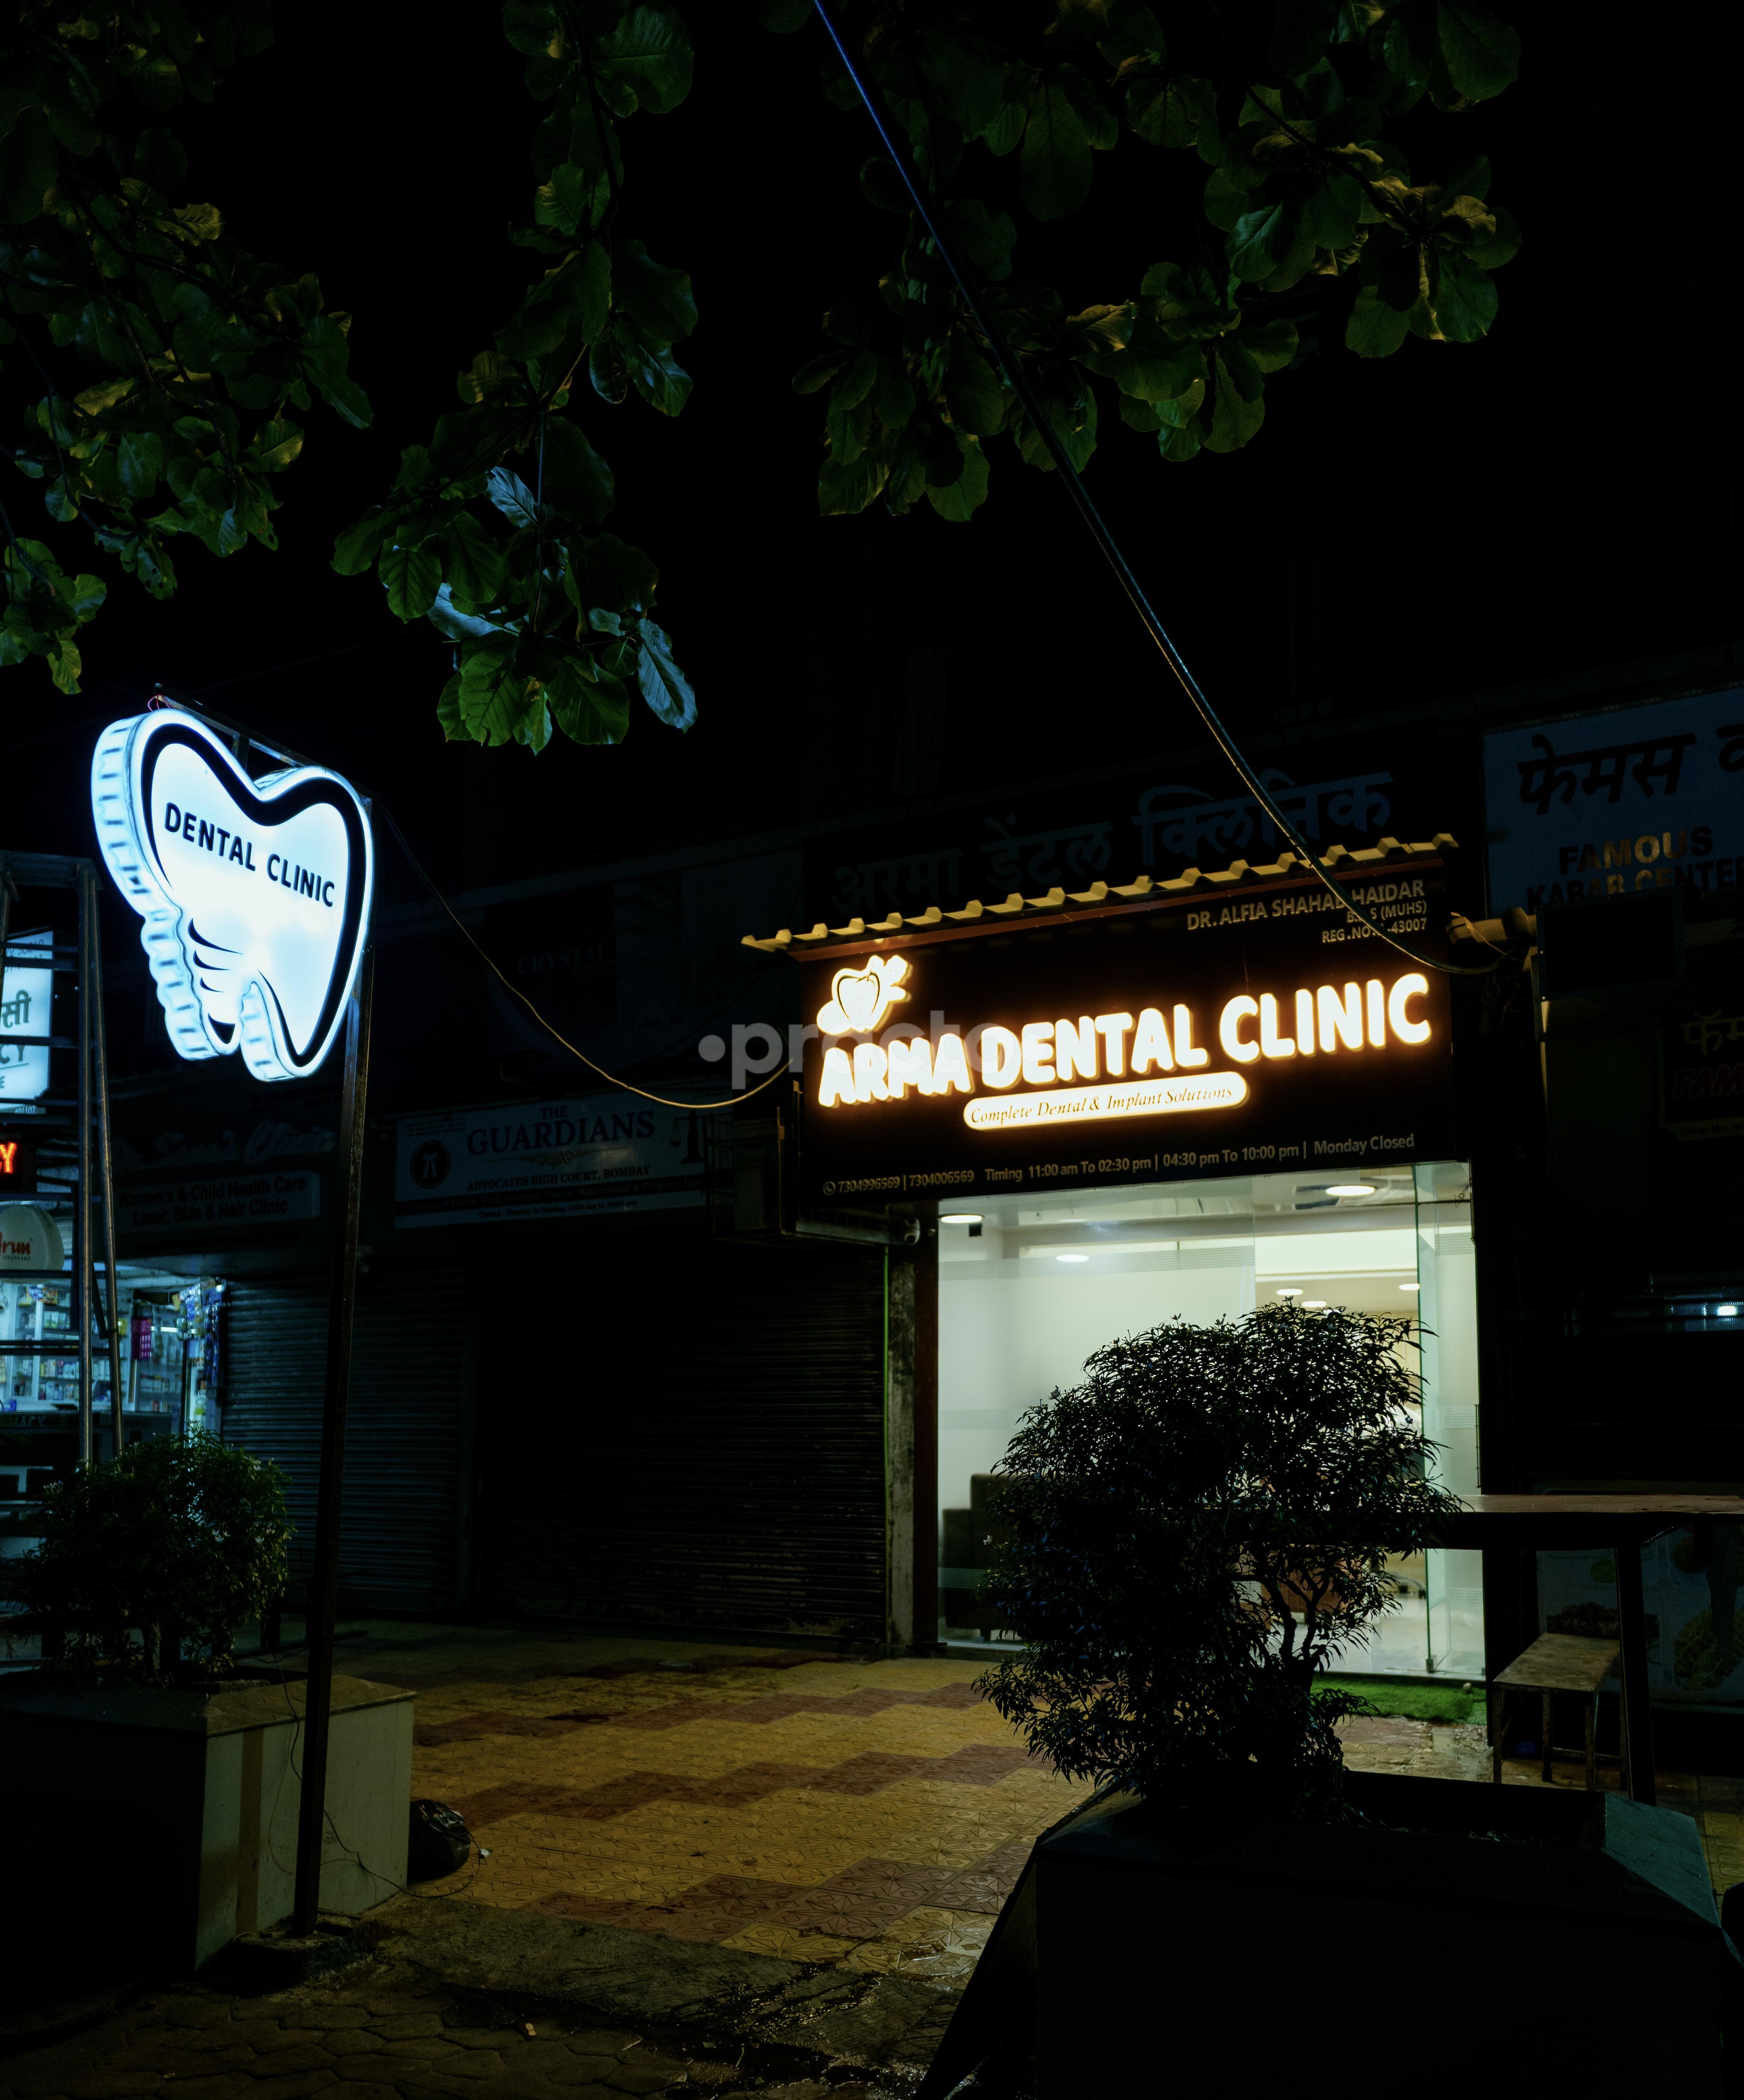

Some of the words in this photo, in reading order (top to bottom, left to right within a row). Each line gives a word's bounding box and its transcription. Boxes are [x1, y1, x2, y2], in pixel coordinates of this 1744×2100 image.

[1518, 733, 1696, 815] फेमस
[165, 802, 255, 871] DENTAL
[267, 854, 334, 907] CLINIC
[831, 846, 964, 916] अरमा
[979, 812, 1114, 891] डेंटल
[1129, 767, 1394, 867] क्लिनिक
[1560, 827, 1713, 874] FAMOUS
[1219, 902, 1268, 925] ALFIA
[1351, 879, 1425, 905] HAIDAR
[1380, 900, 1427, 920] (MUHS)
[818, 1033, 973, 1107] ARMA
[981, 1004, 1209, 1089] DENTAL
[1219, 973, 1431, 1063] CLINIC
[541, 1105, 568, 1119] THE
[971, 1107, 1033, 1124] Complete
[1037, 1098, 1087, 1116] Dental
[1090, 1099, 1100, 1110] &
[1107, 1093, 1163, 1110] Implant
[1165, 1088, 1233, 1105] Solutions
[467, 1110, 655, 1156] GUARDIANS
[467, 1176, 528, 1191] ADVOCATES
[531, 1174, 558, 1185] HIGH
[560, 1172, 601, 1183] COURT,
[603, 1165, 651, 1179] BOMBAY
[837, 1176, 900, 1193] 7304996569
[908, 1170, 975, 1187] 7304006569
[984, 1167, 1023, 1183] Timing
[1028, 1163, 1058, 1178] 11:00
[1060, 1165, 1078, 1176] am
[1080, 1161, 1096, 1174] To
[1098, 1157, 1130, 1173] 02:30
[1132, 1159, 1152, 1173] pm
[1162, 1152, 1196, 1168] 04:30
[1199, 1154, 1220, 1168] pm
[1222, 1149, 1238, 1163] To
[1242, 1145, 1276, 1161] 10:00
[1279, 1145, 1299, 1161] pm
[1314, 1138, 1368, 1156] Monday
[1370, 1133, 1415, 1150] Closed
[119, 1188, 175, 1207] Women's
[178, 1186, 186, 1202] &
[191, 1182, 223, 1201] Child
[228, 1178, 270, 1198] Health
[274, 1176, 306, 1194] Care
[133, 1210, 170, 1226] Laser,
[173, 1205, 202, 1223] Skin
[205, 1203, 214, 1220] &
[219, 1201, 247, 1219] Hair
[249, 1197, 287, 1216] Clinic
